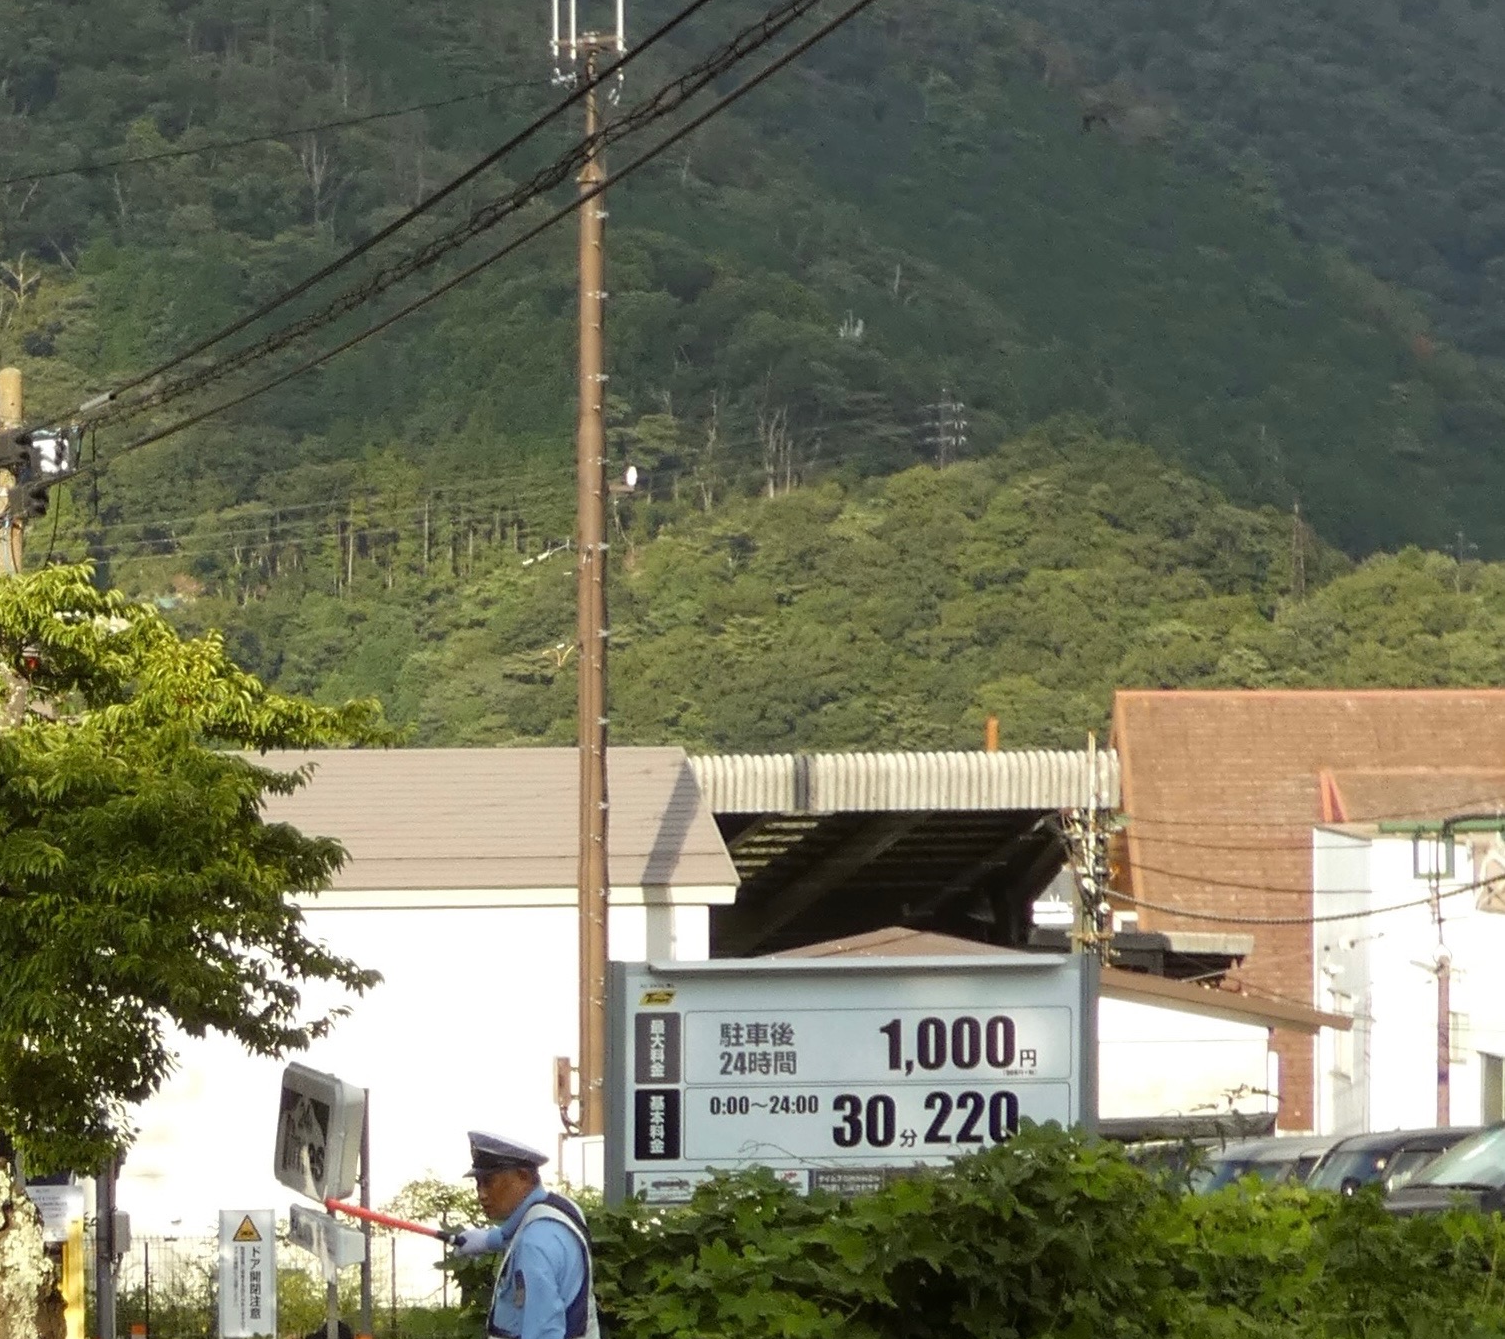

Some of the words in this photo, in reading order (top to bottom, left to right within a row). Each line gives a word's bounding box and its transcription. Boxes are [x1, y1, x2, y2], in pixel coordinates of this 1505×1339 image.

[719, 1022, 795, 1048] 駐車後
[719, 1050, 797, 1076] 24時間
[649, 1094, 666, 1155] 基本料金
[249, 1246, 262, 1320] ドア開閉注意
